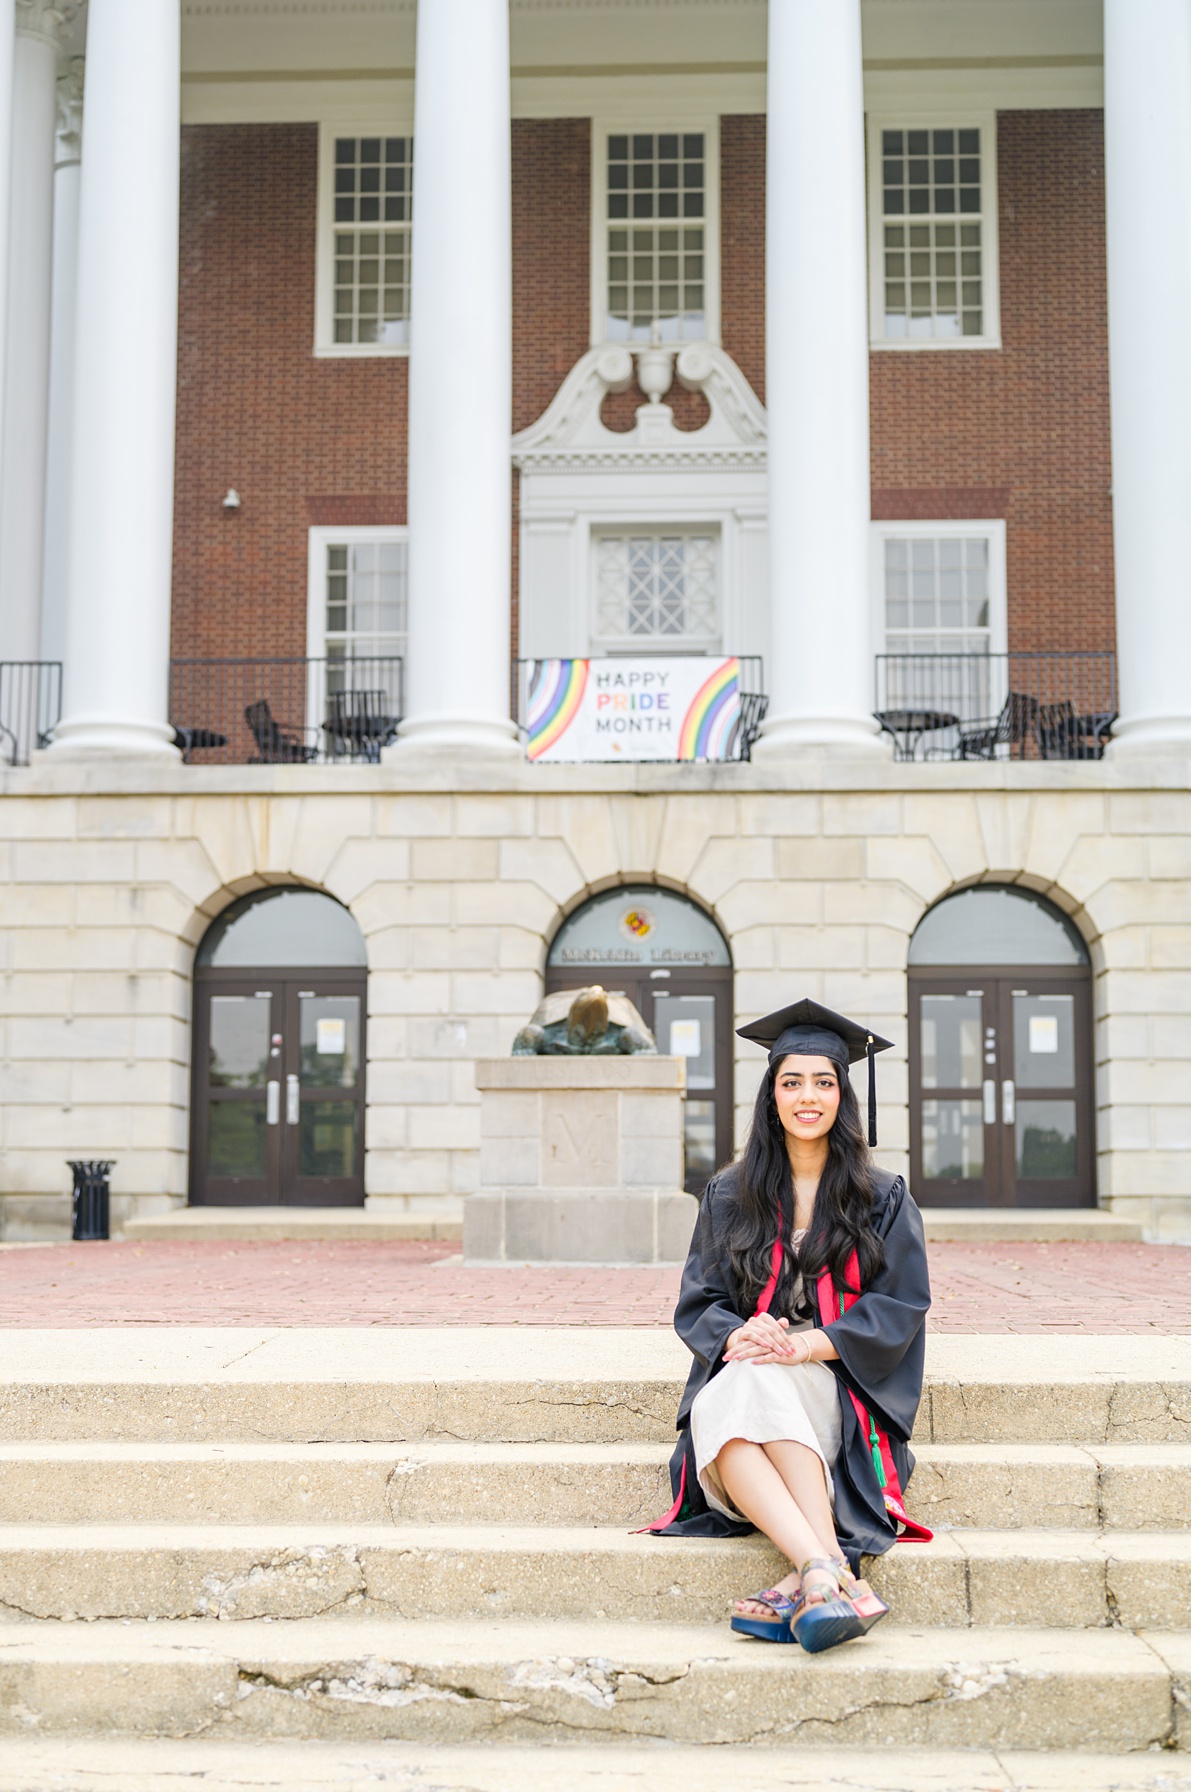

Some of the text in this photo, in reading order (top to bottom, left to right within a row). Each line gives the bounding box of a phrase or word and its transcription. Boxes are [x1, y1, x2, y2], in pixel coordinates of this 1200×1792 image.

[596, 672, 669, 687] HAPPY
[597, 693, 669, 710] PRIDE
[596, 717, 671, 733] MONTH
[651, 949, 714, 965] Library
